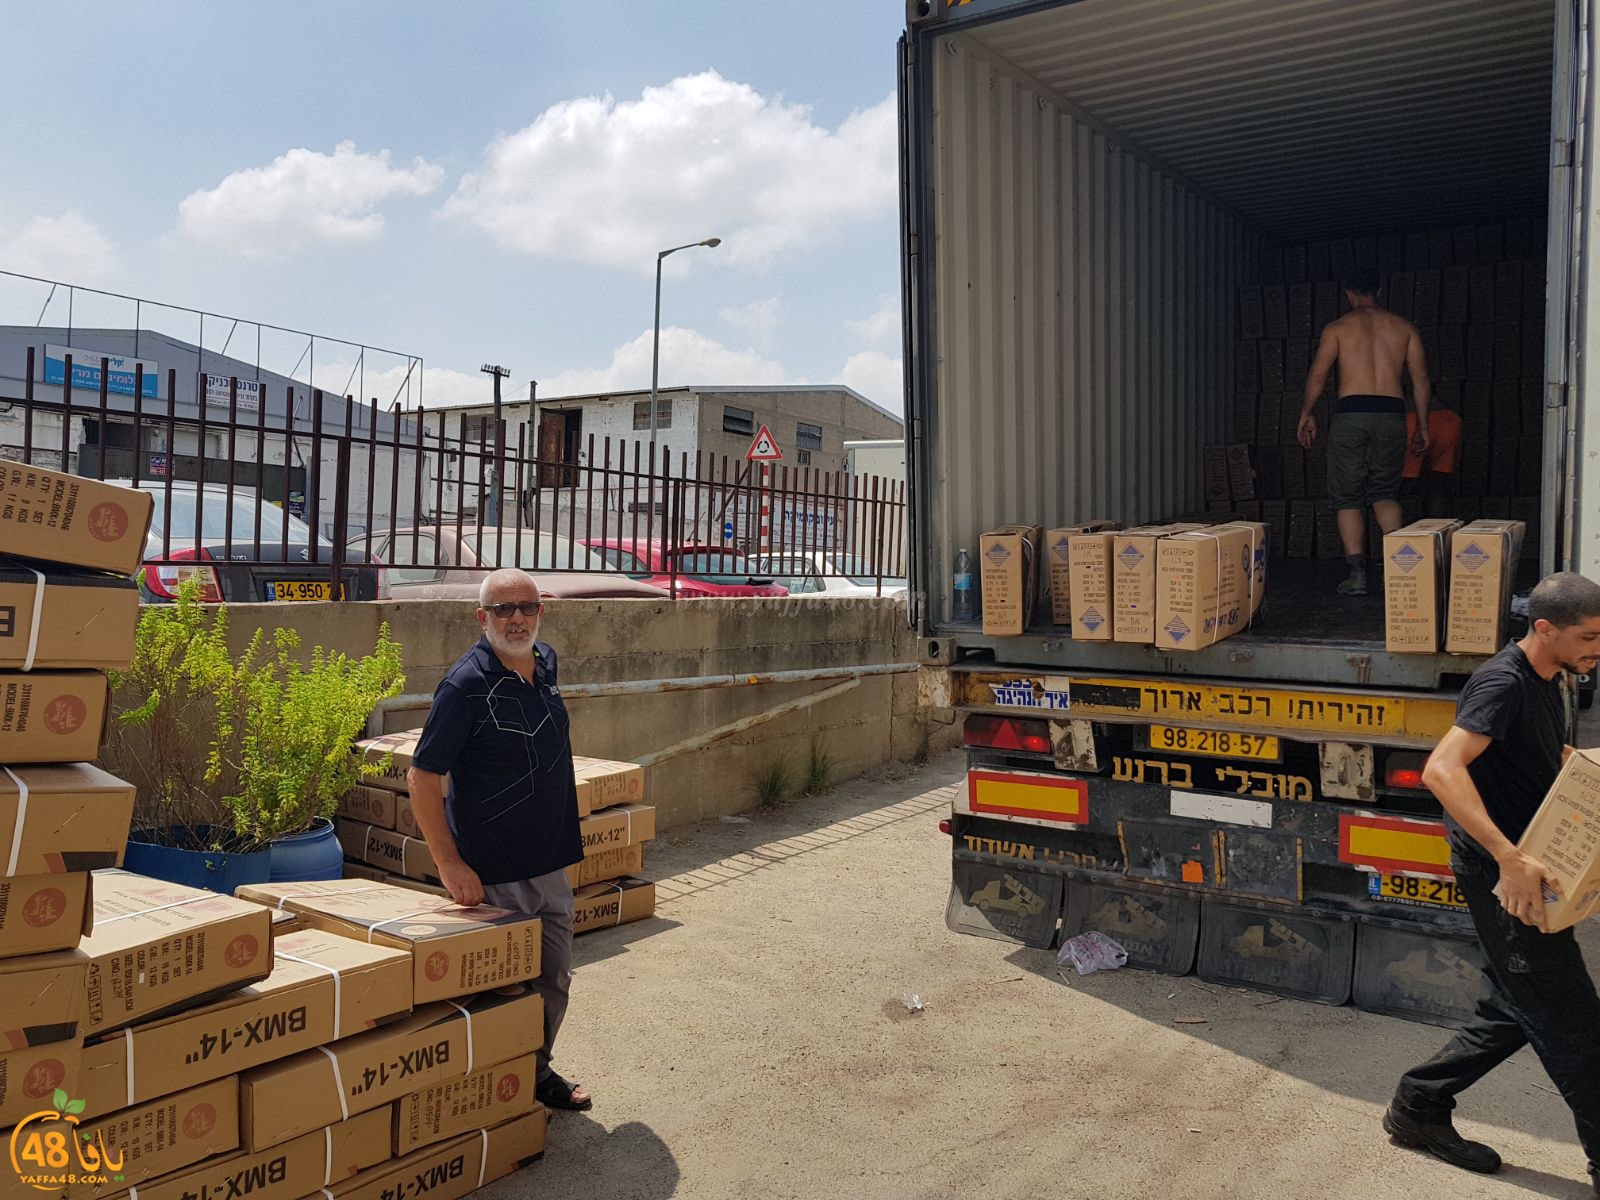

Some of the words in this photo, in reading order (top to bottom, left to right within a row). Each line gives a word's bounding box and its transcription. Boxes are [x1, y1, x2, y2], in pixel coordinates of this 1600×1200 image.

[2, 504, 15, 520] KGS
[17, 508, 29, 523] KGS
[33, 510, 43, 525] SET
[1044, 691, 1070, 711] איך
[1144, 686, 1202, 713] ארוך
[1218, 693, 1271, 717] רכב
[1112, 756, 1194, 789] ברנע
[1215, 765, 1313, 803] מובלי
[963, 834, 1036, 861] אשדוד
[185, 1005, 307, 1065] BMX-14"
[351, 1040, 450, 1096] BMX-14"
